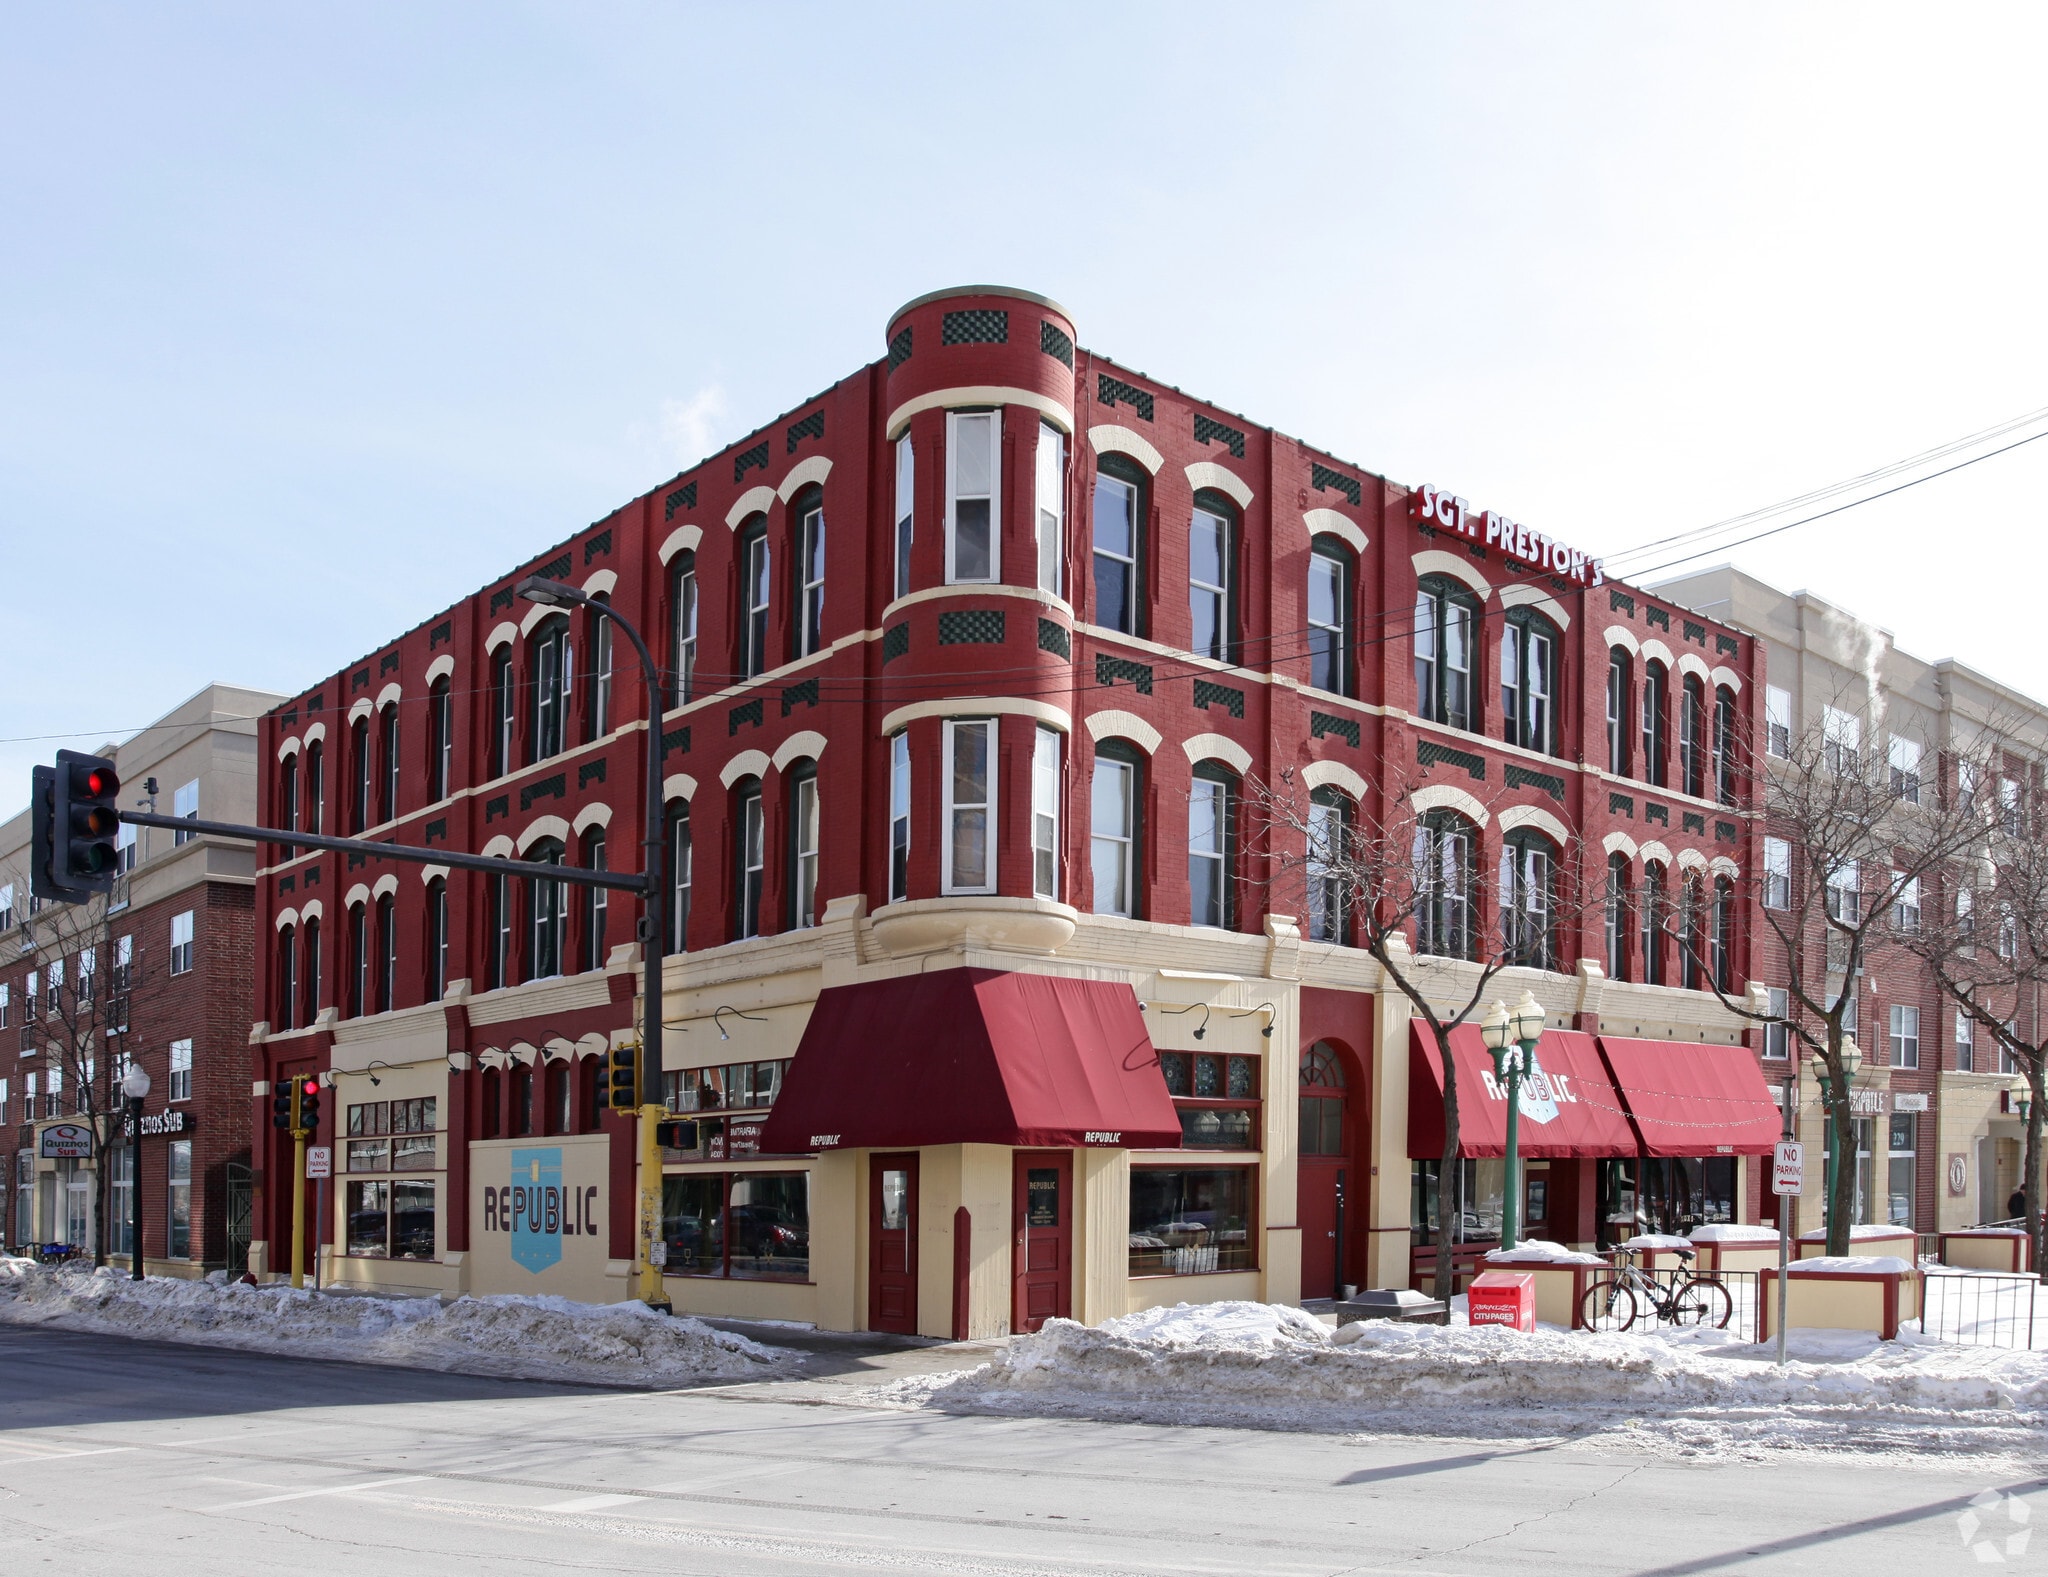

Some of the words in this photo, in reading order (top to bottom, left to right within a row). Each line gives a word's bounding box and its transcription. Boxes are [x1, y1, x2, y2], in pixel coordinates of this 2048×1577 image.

[1422, 483, 1475, 537] SGT.
[1484, 510, 1604, 587] PRESTON'S
[810, 1134, 841, 1146] REPUBLIC
[1084, 1131, 1121, 1143] REPUBLIC
[1892, 1132, 1905, 1146] 229
[314, 1151, 325, 1159] NO
[1783, 1148, 1798, 1162] NO
[1776, 1164, 1801, 1176] PARKING
[1028, 1181, 1056, 1190] REPUBLIC
[484, 1185, 598, 1236] REPUBLIC
[1473, 1311, 1491, 1320] CITY
[1490, 1312, 1514, 1321] PAGES
